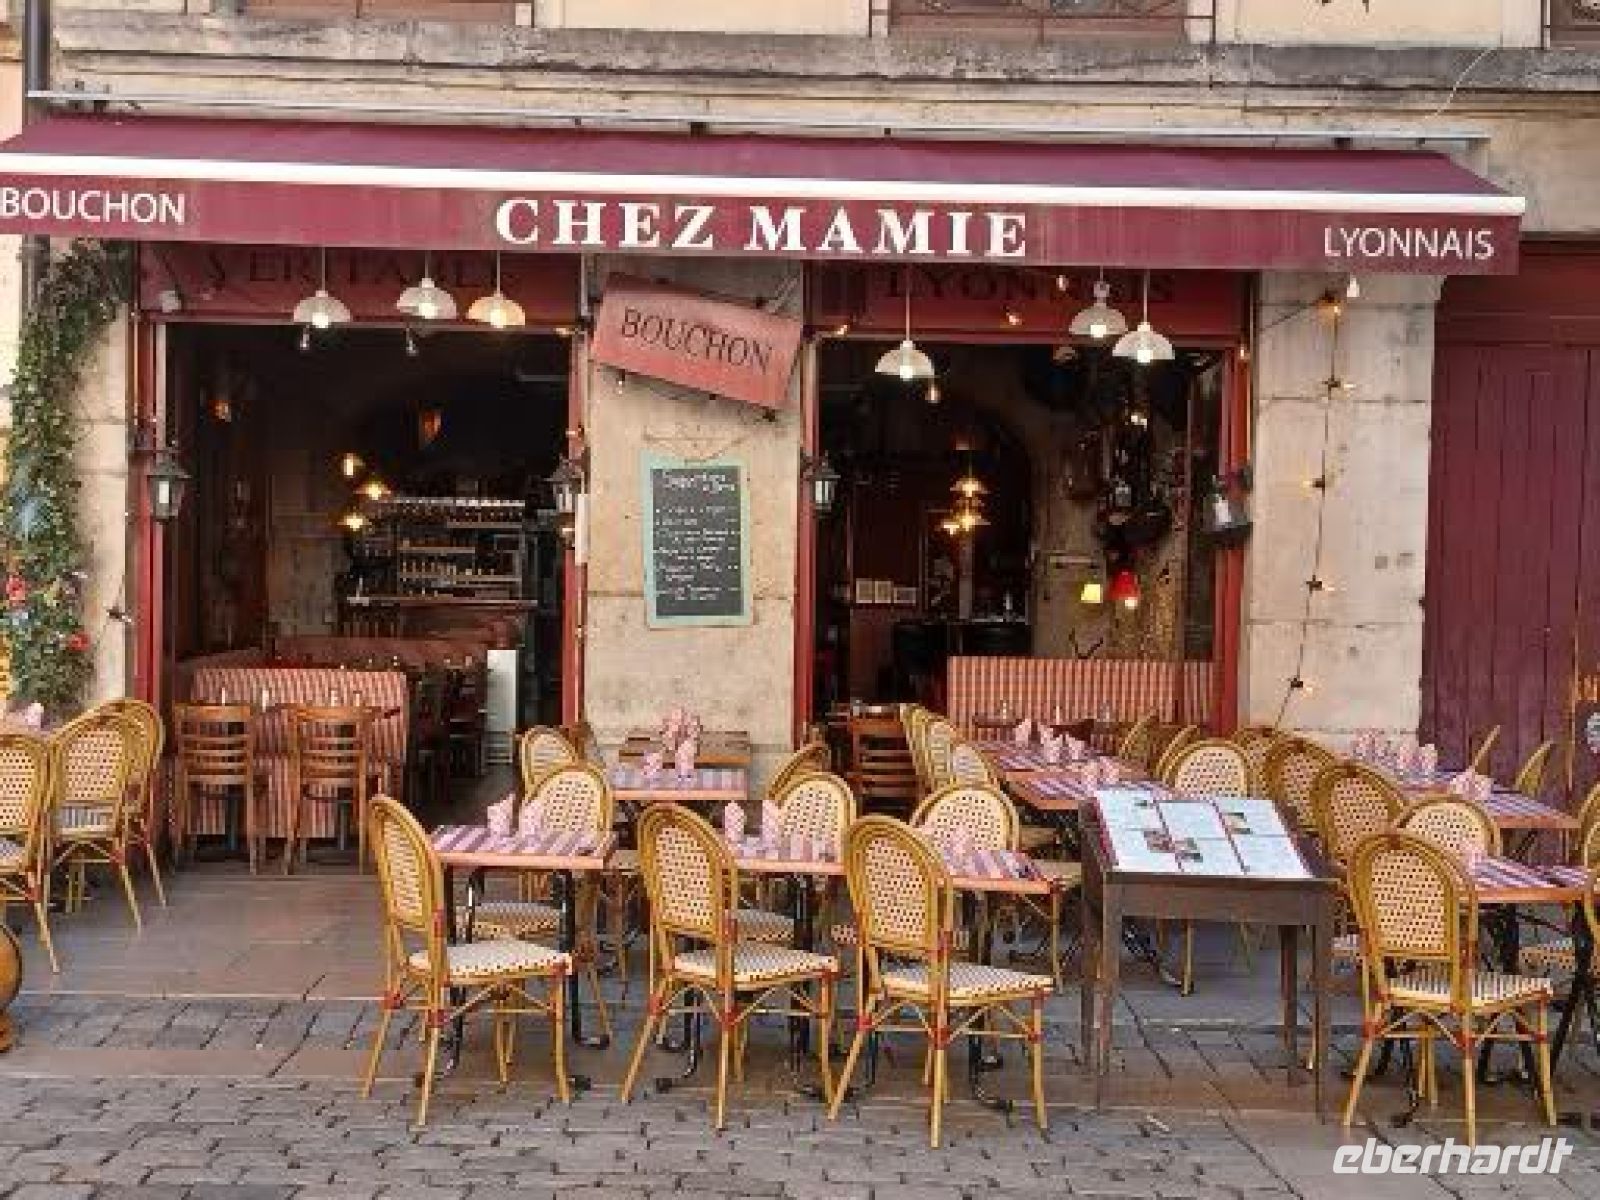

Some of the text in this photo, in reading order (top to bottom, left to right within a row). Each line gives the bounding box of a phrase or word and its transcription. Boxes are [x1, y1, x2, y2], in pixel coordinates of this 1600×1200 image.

[0, 187, 185, 225] BOUCHON
[496, 199, 1026, 258] CHEZ MAMIE
[1324, 225, 1495, 260] LYONNAIS
[621, 306, 773, 375] BOUCHON
